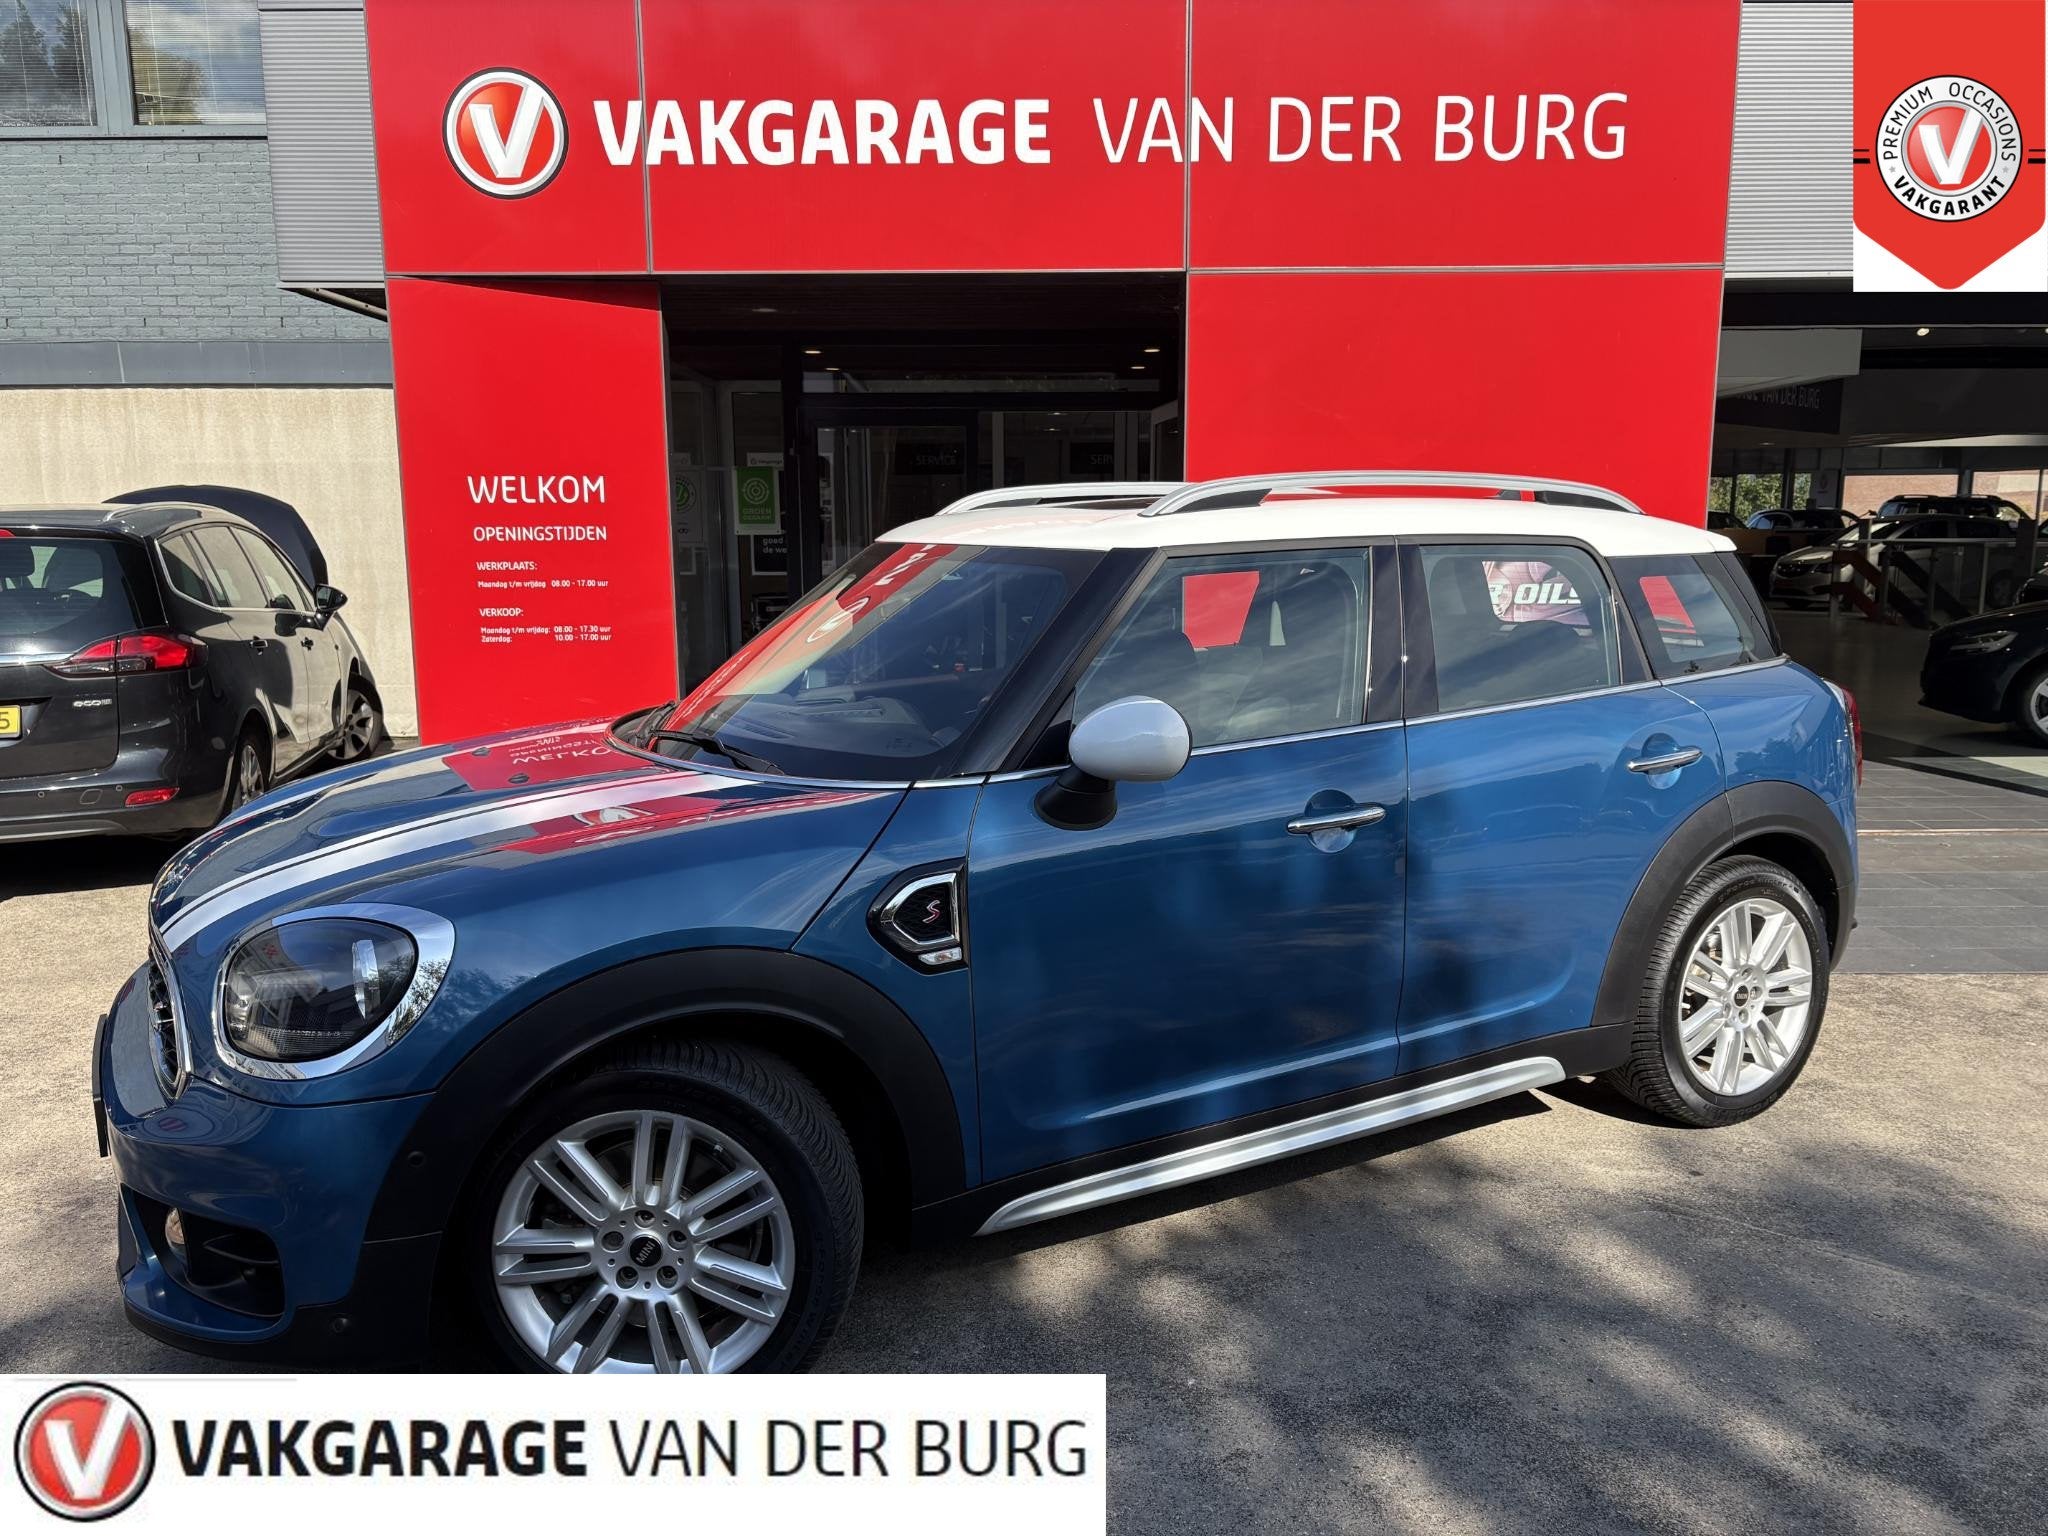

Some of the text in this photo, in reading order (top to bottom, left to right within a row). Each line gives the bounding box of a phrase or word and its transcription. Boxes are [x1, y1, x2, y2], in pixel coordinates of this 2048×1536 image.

[593, 92, 1628, 166] VAKGARAGE VAN DER BURG
[467, 475, 605, 504] WELKOM
[473, 525, 607, 542] OPENINGSTIJDEN
[476, 560, 538, 571] WERKPLAATS:
[551, 579, 571, 588] 08.00
[577, 579, 596, 587] 17.00
[479, 607, 524, 617] VERKOOP:
[580, 633, 599, 642] 17.00
[921, 899, 941, 924] S
[635, 1240, 656, 1264] MINI
